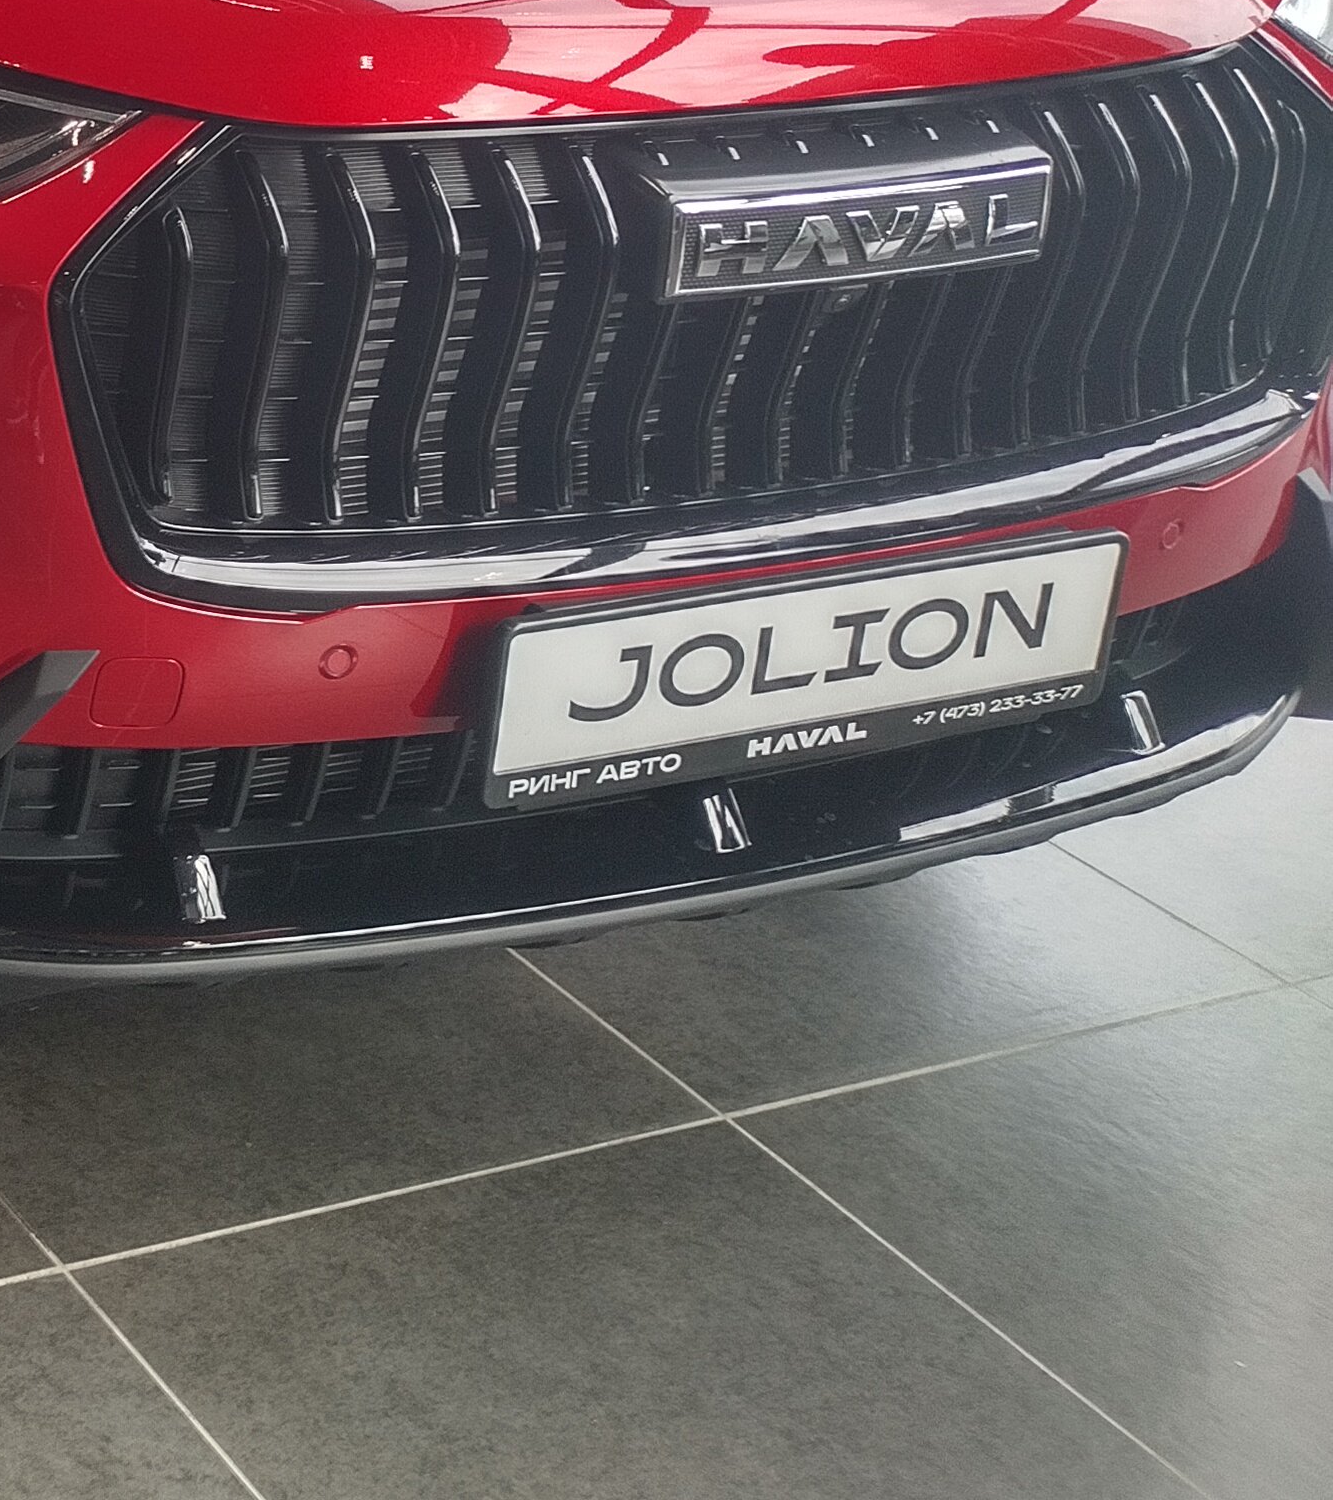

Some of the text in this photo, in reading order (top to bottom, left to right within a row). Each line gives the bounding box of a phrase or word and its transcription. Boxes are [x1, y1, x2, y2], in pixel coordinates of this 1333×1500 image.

[696, 193, 1039, 278] HAVAL
[568, 581, 1054, 723] JOLION
[911, 683, 1085, 725] +7 (473) 233-33-77
[746, 721, 869, 759] HAVAL
[507, 752, 683, 799] РИНГ АВТО
